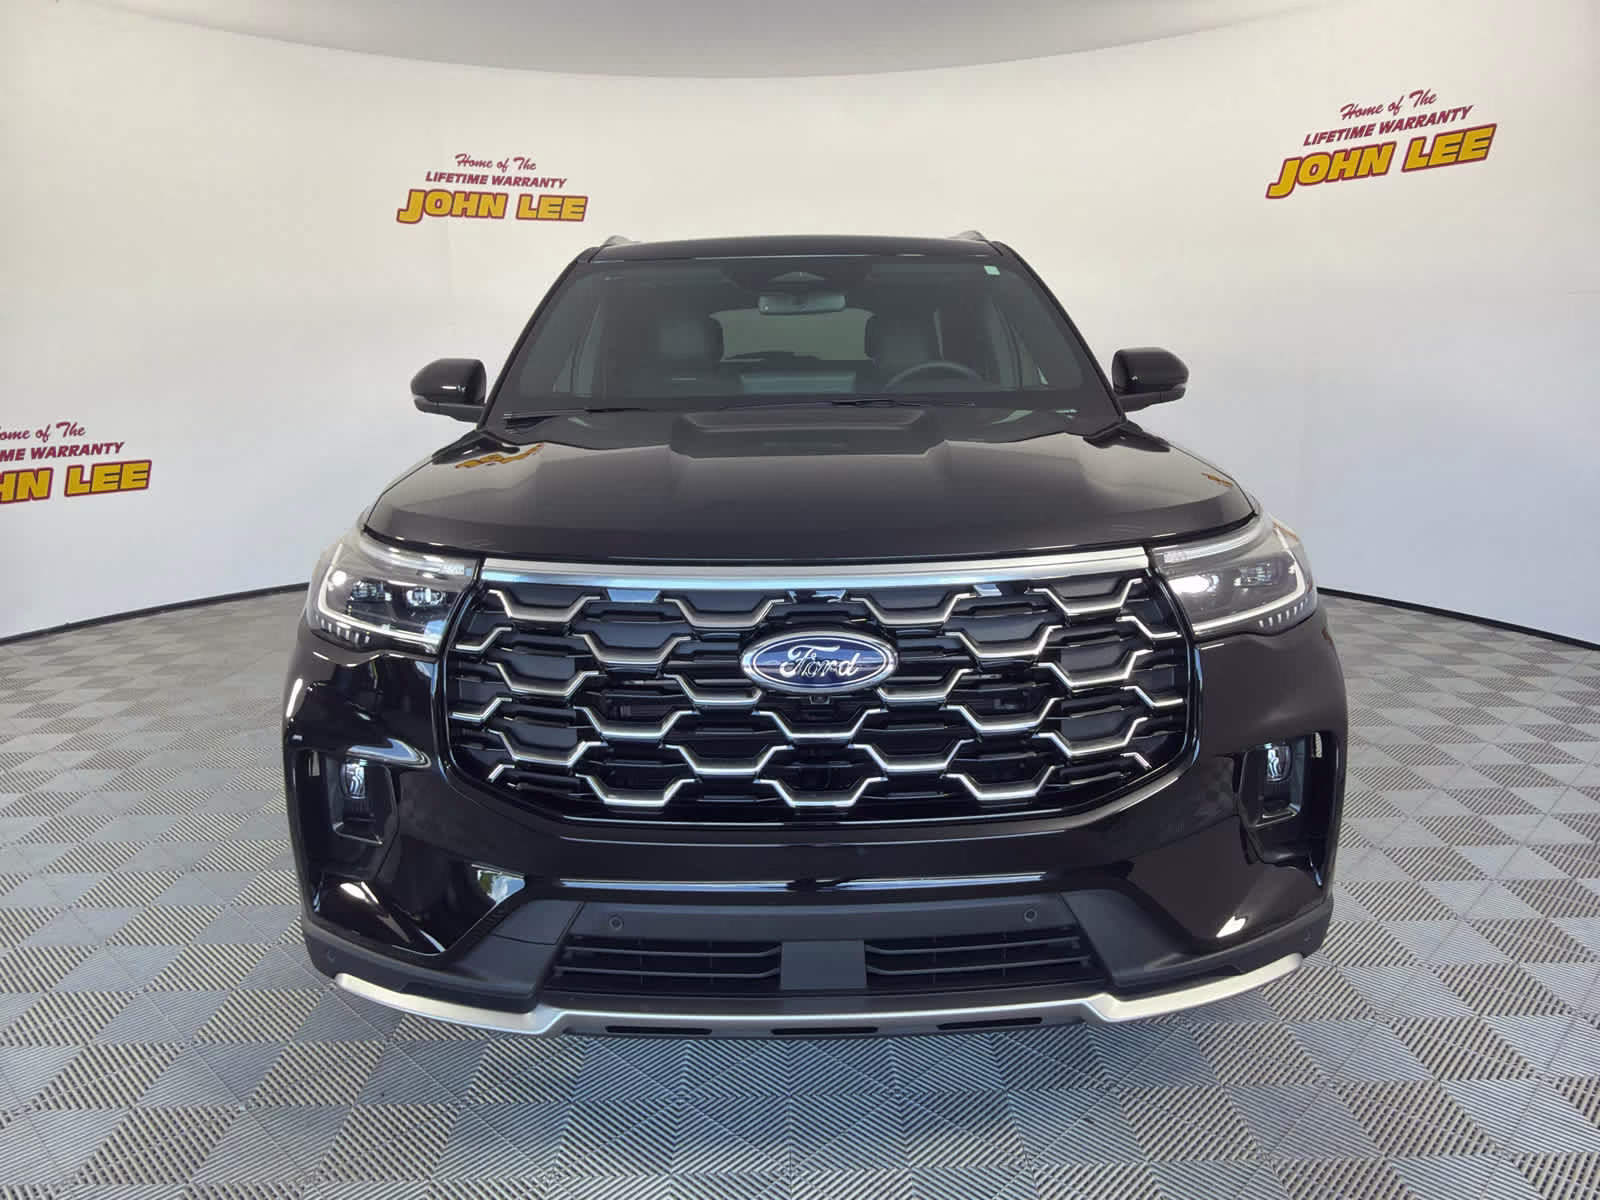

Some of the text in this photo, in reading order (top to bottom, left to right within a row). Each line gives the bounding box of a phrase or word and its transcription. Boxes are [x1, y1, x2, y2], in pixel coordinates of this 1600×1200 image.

[1340, 89, 1437, 120] Home of The
[1303, 105, 1473, 146] LIFETIME WARRANTY
[455, 153, 537, 172] Home of The
[1266, 123, 1497, 199] JOHN LEE
[425, 171, 567, 188] LIFETIME WARRANTY
[396, 189, 588, 224] JOHN LEE
[0, 421, 86, 442] ome of The
[31, 442, 124, 460] WARRANTY
[64, 459, 152, 497] LEE
[779, 644, 860, 677] Ford
